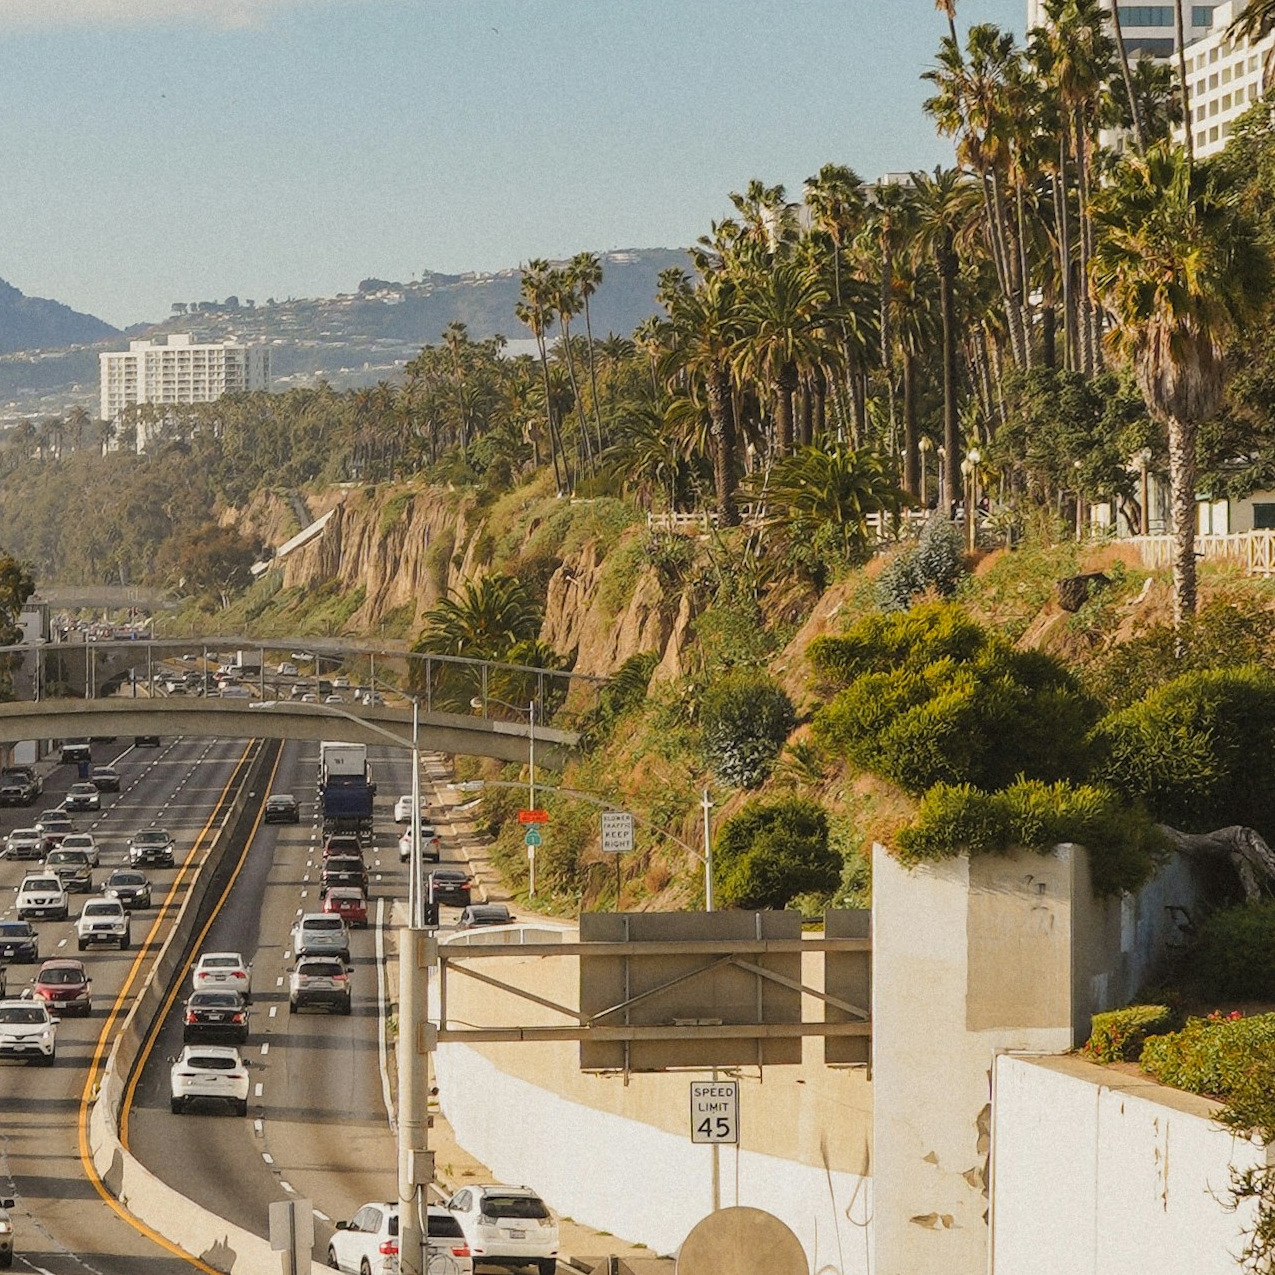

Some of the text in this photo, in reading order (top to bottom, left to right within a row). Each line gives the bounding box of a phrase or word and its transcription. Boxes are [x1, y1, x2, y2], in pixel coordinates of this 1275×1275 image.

[604, 840, 630, 848] RIGHT
[694, 1087, 733, 1097] SPEED
[698, 1102, 729, 1112] LIMIT
[697, 1117, 730, 1138] 45
